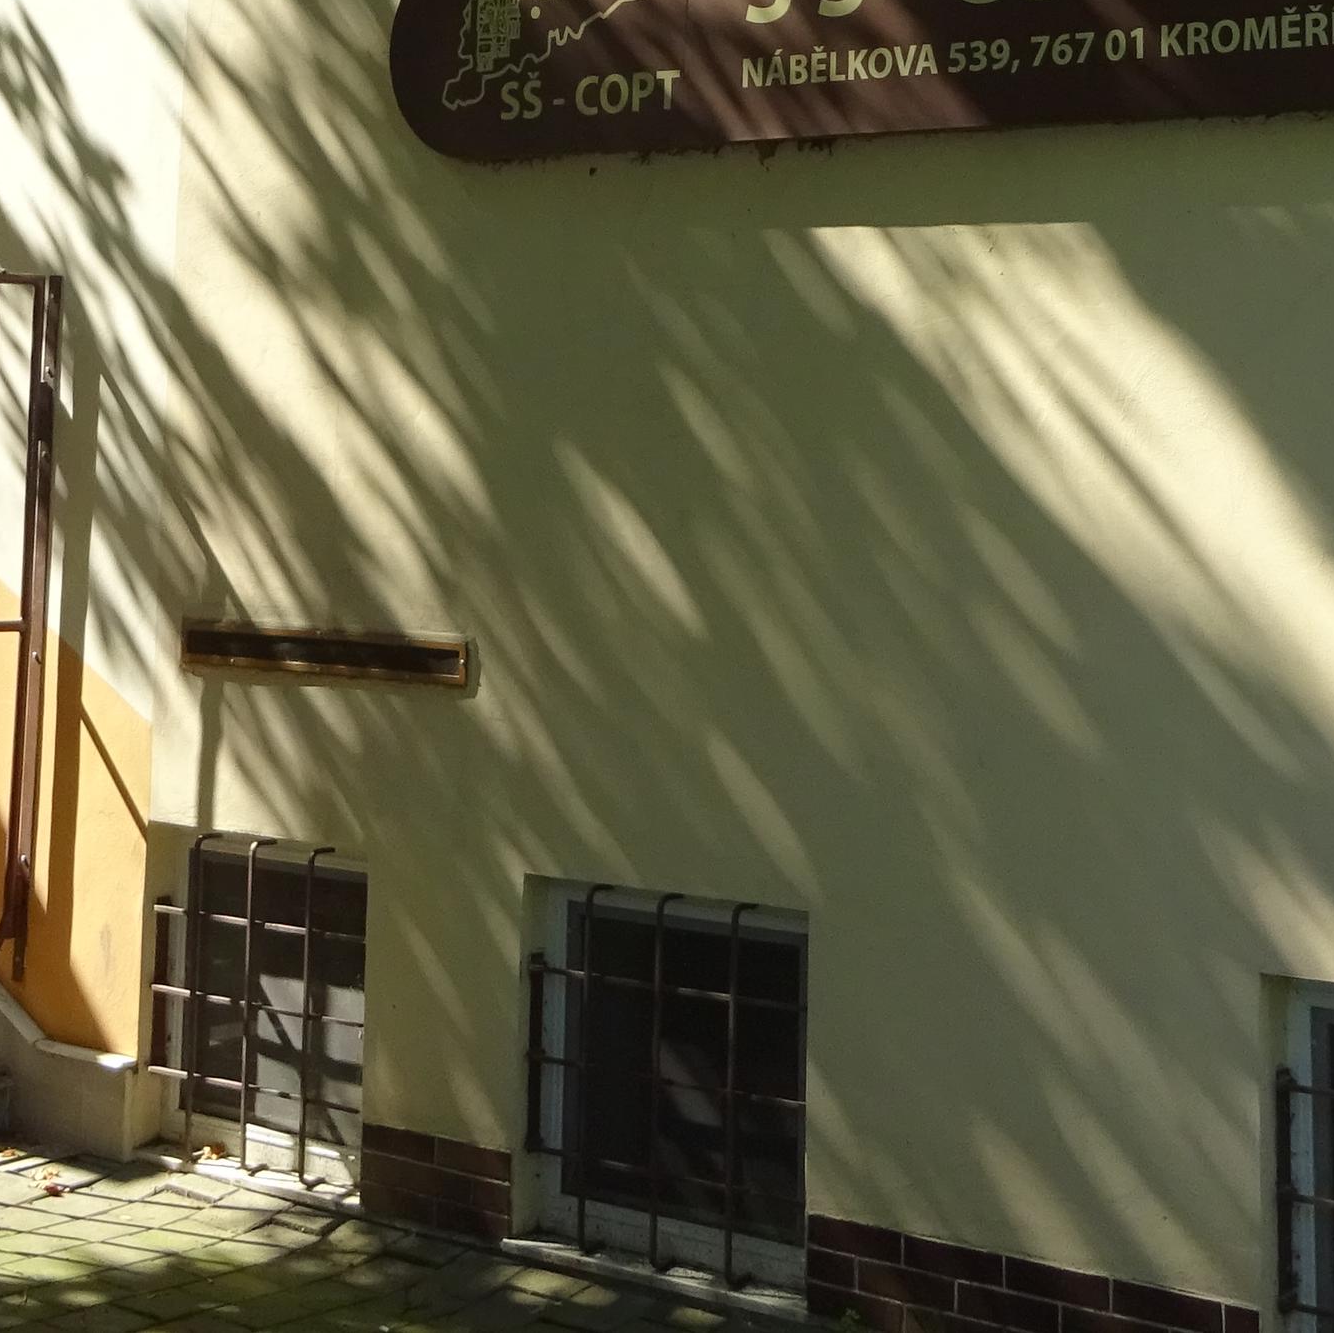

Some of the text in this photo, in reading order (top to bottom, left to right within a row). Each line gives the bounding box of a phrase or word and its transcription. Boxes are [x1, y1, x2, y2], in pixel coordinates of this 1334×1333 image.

[740, 42, 939, 89] NÁBĚLKOVA
[947, 37, 1020, 74] 539,
[1031, 31, 1095, 65] 767
[1104, 26, 1147, 61] 01
[500, 71, 542, 120] SŠ
[575, 69, 681, 116] COPT
